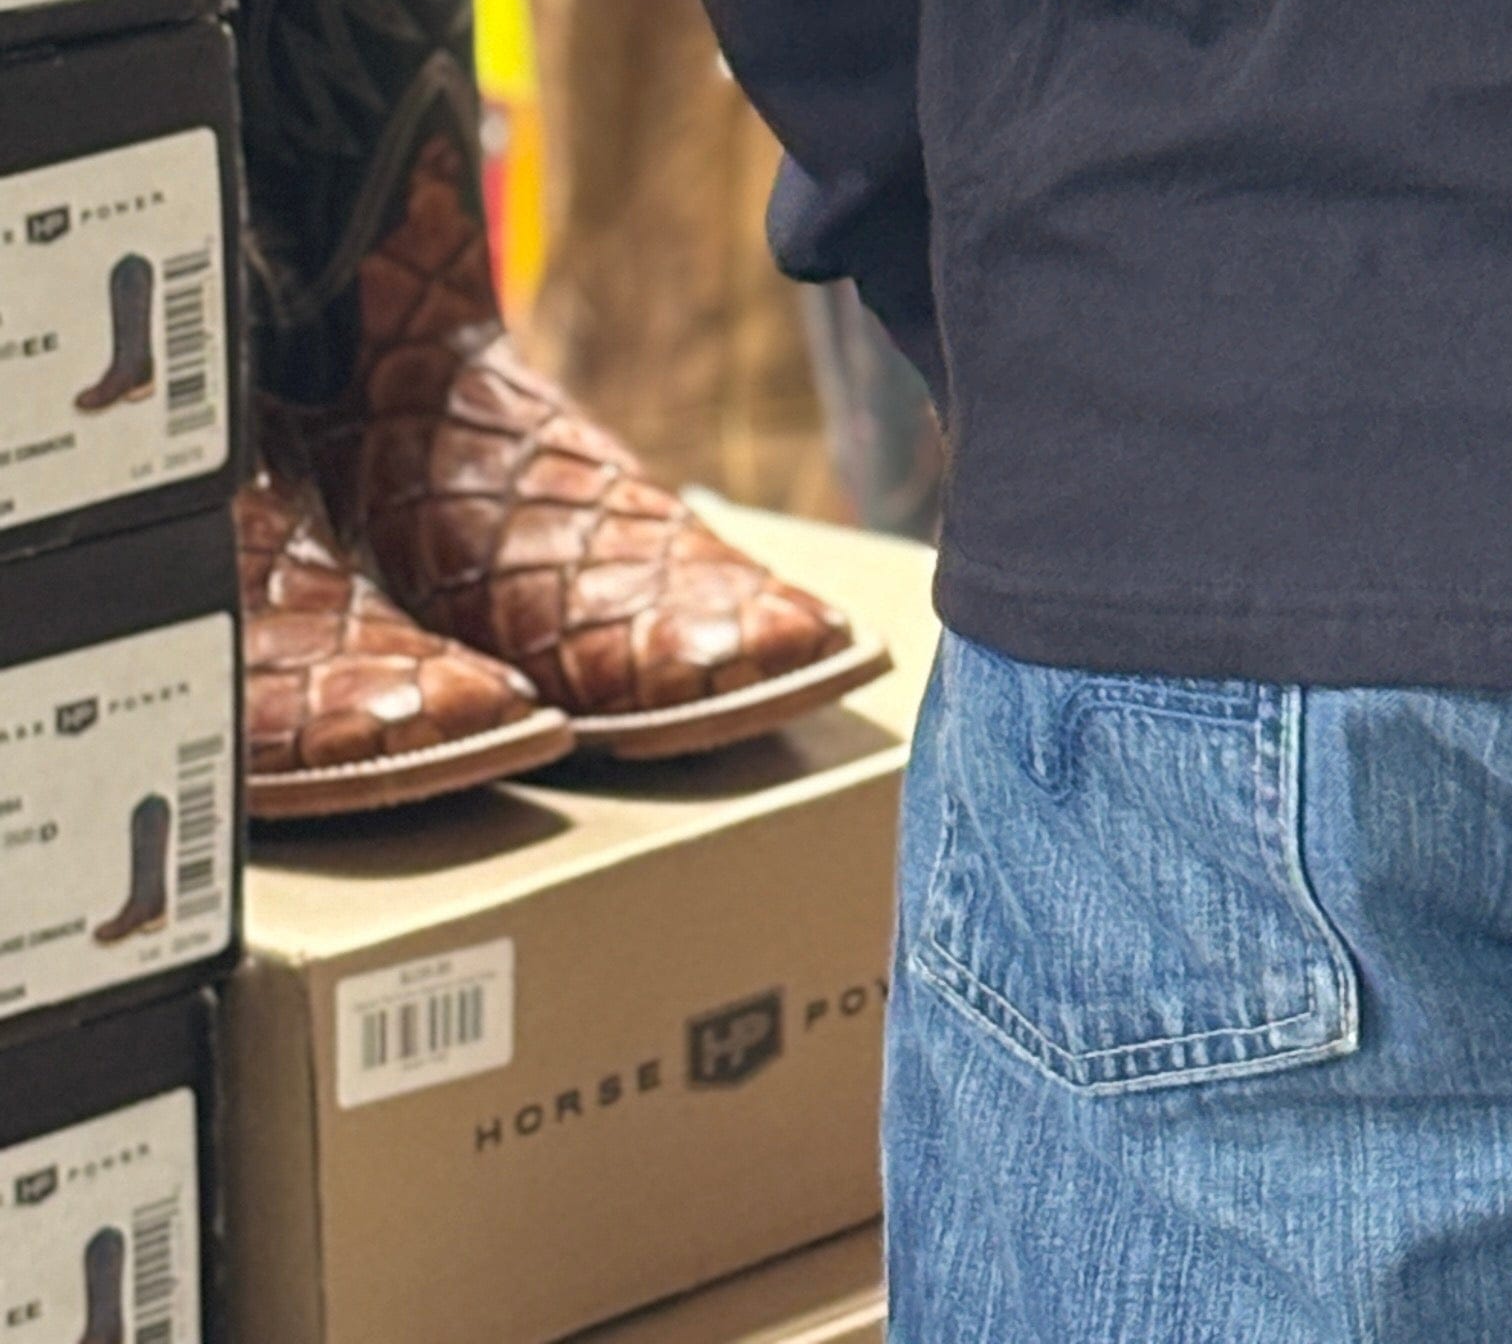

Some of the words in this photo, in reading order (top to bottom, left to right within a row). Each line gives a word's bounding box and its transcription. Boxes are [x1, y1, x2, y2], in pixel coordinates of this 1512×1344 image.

[81, 191, 164, 223] POWER
[107, 682, 189, 713] POWER
[475, 1058, 661, 1152] HORSE
[67, 1143, 149, 1181] POWER
